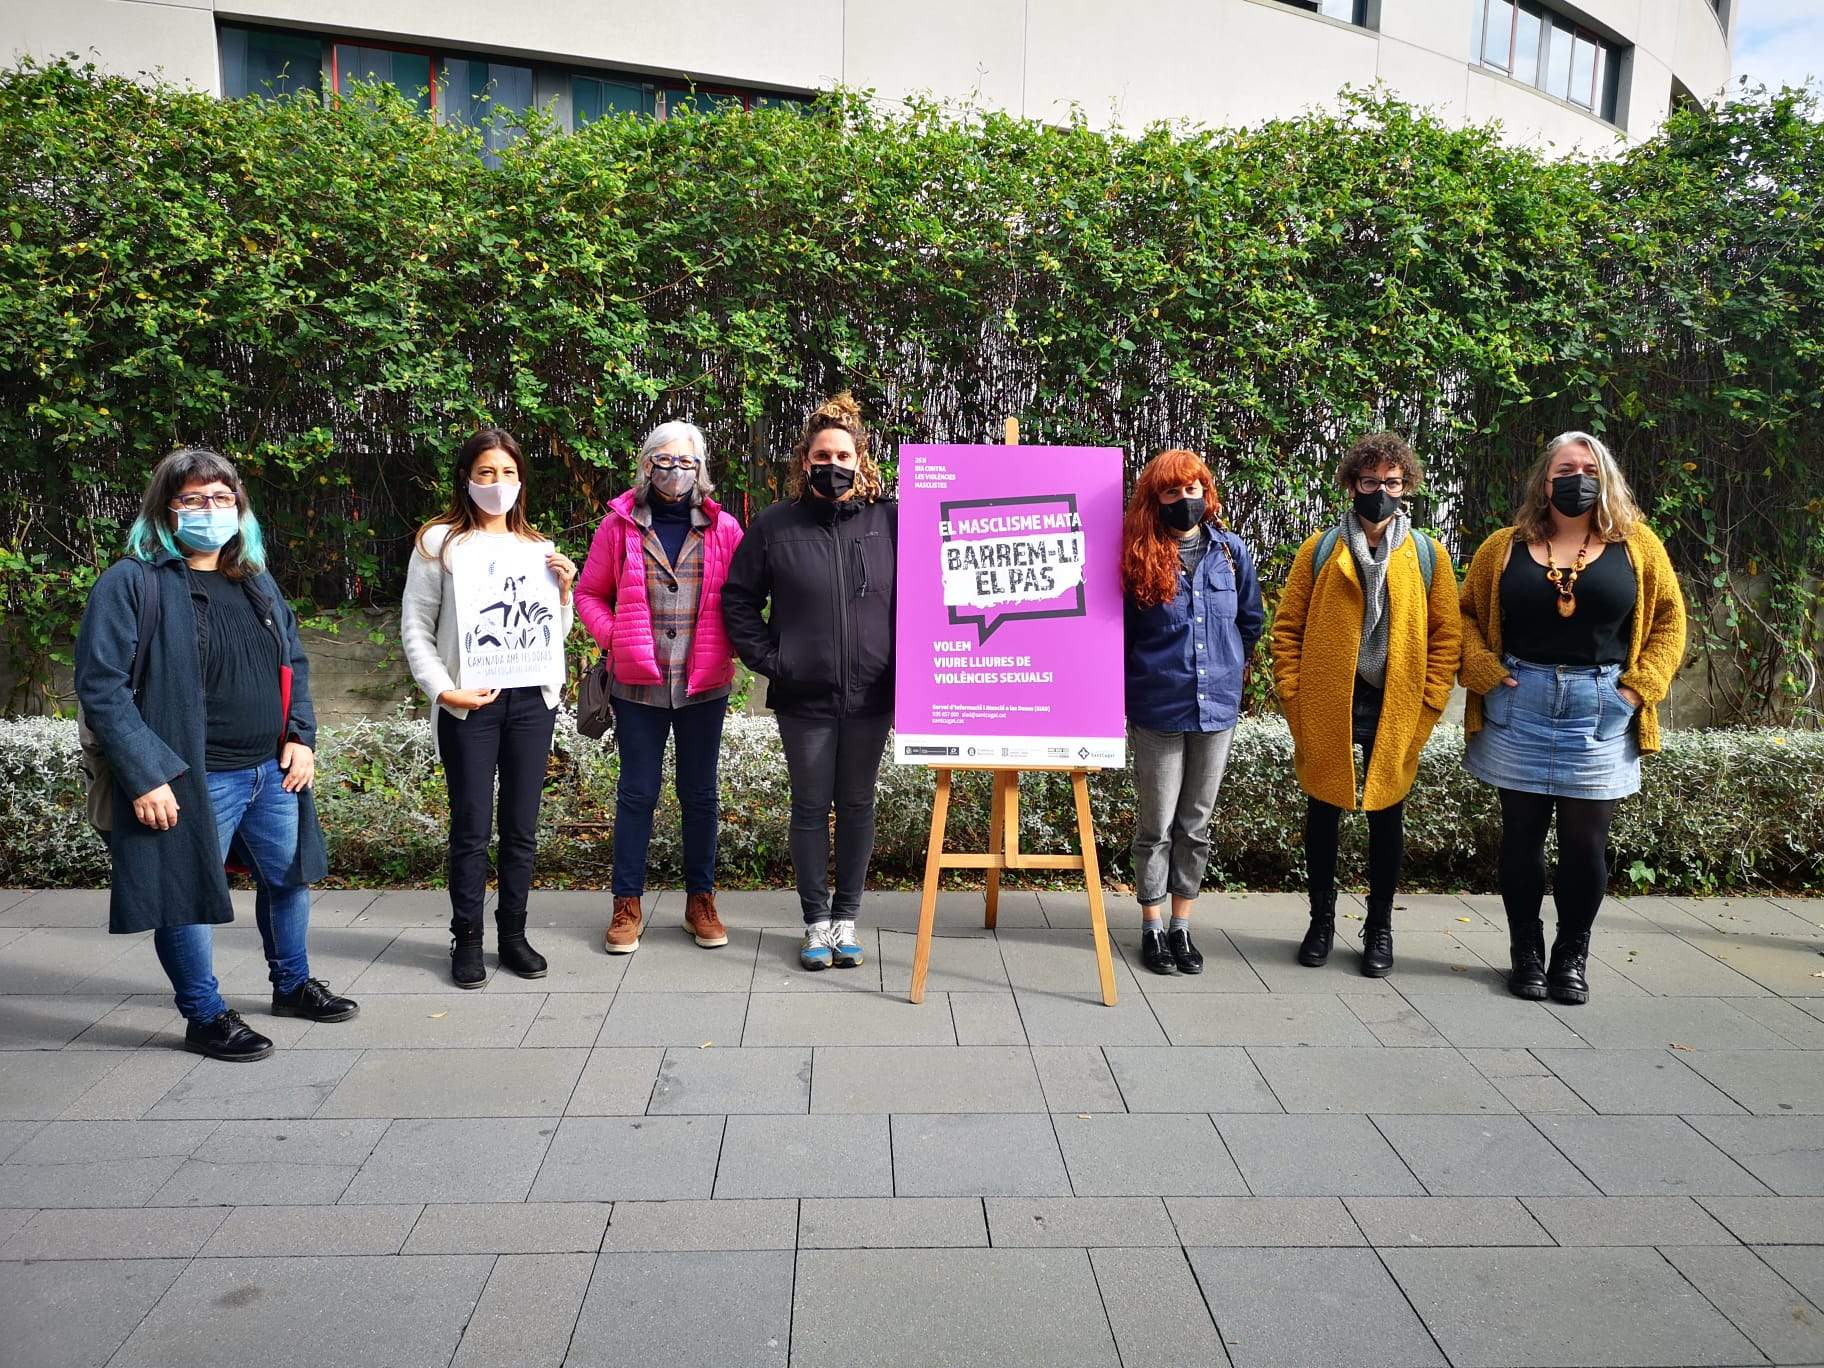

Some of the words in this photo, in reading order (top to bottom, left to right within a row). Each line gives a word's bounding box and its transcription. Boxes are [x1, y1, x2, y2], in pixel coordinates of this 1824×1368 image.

[925, 472, 956, 481] VIOLÈNCIES
[939, 521, 956, 536] EL
[958, 514, 1041, 535] MASCLISME
[1043, 512, 1082, 528] MATA
[947, 538, 1079, 571] BARREM-LI
[975, 570, 1004, 595] EL
[1008, 566, 1055, 594] PAS
[933, 640, 972, 652] VOLEM
[467, 655, 504, 668] CAMINADA
[506, 652, 519, 664] AMB
[933, 657, 968, 668] VIURE
[969, 656, 1014, 668] LLIURES
[1016, 656, 1031, 667] DE
[934, 670, 998, 684] VIOLÈNCIES
[1000, 671, 1053, 684] SEXUALS!
